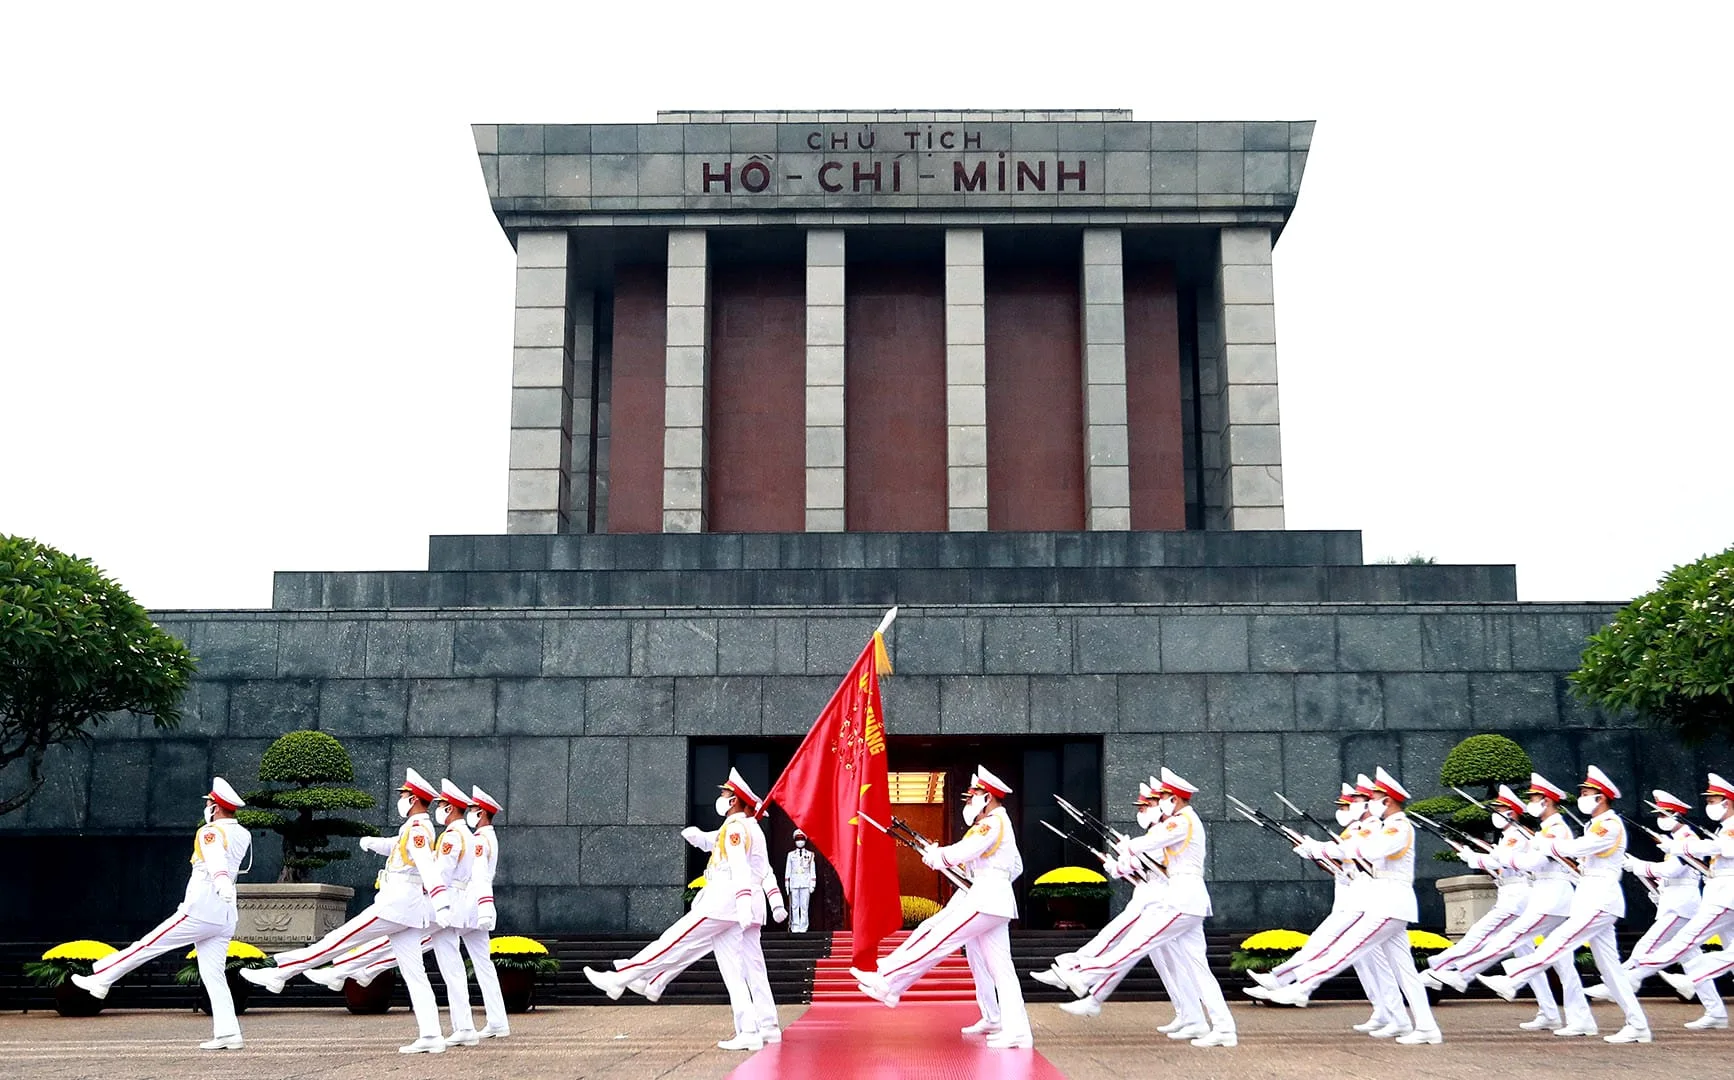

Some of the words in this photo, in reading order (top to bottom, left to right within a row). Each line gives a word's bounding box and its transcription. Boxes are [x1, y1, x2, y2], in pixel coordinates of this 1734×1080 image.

[807, 124, 876, 150] CHỦ
[904, 125, 982, 157] TỊCH
[702, 154, 774, 193] HỒ
[817, 153, 904, 193] CHÍ
[953, 152, 1086, 192] MINH
